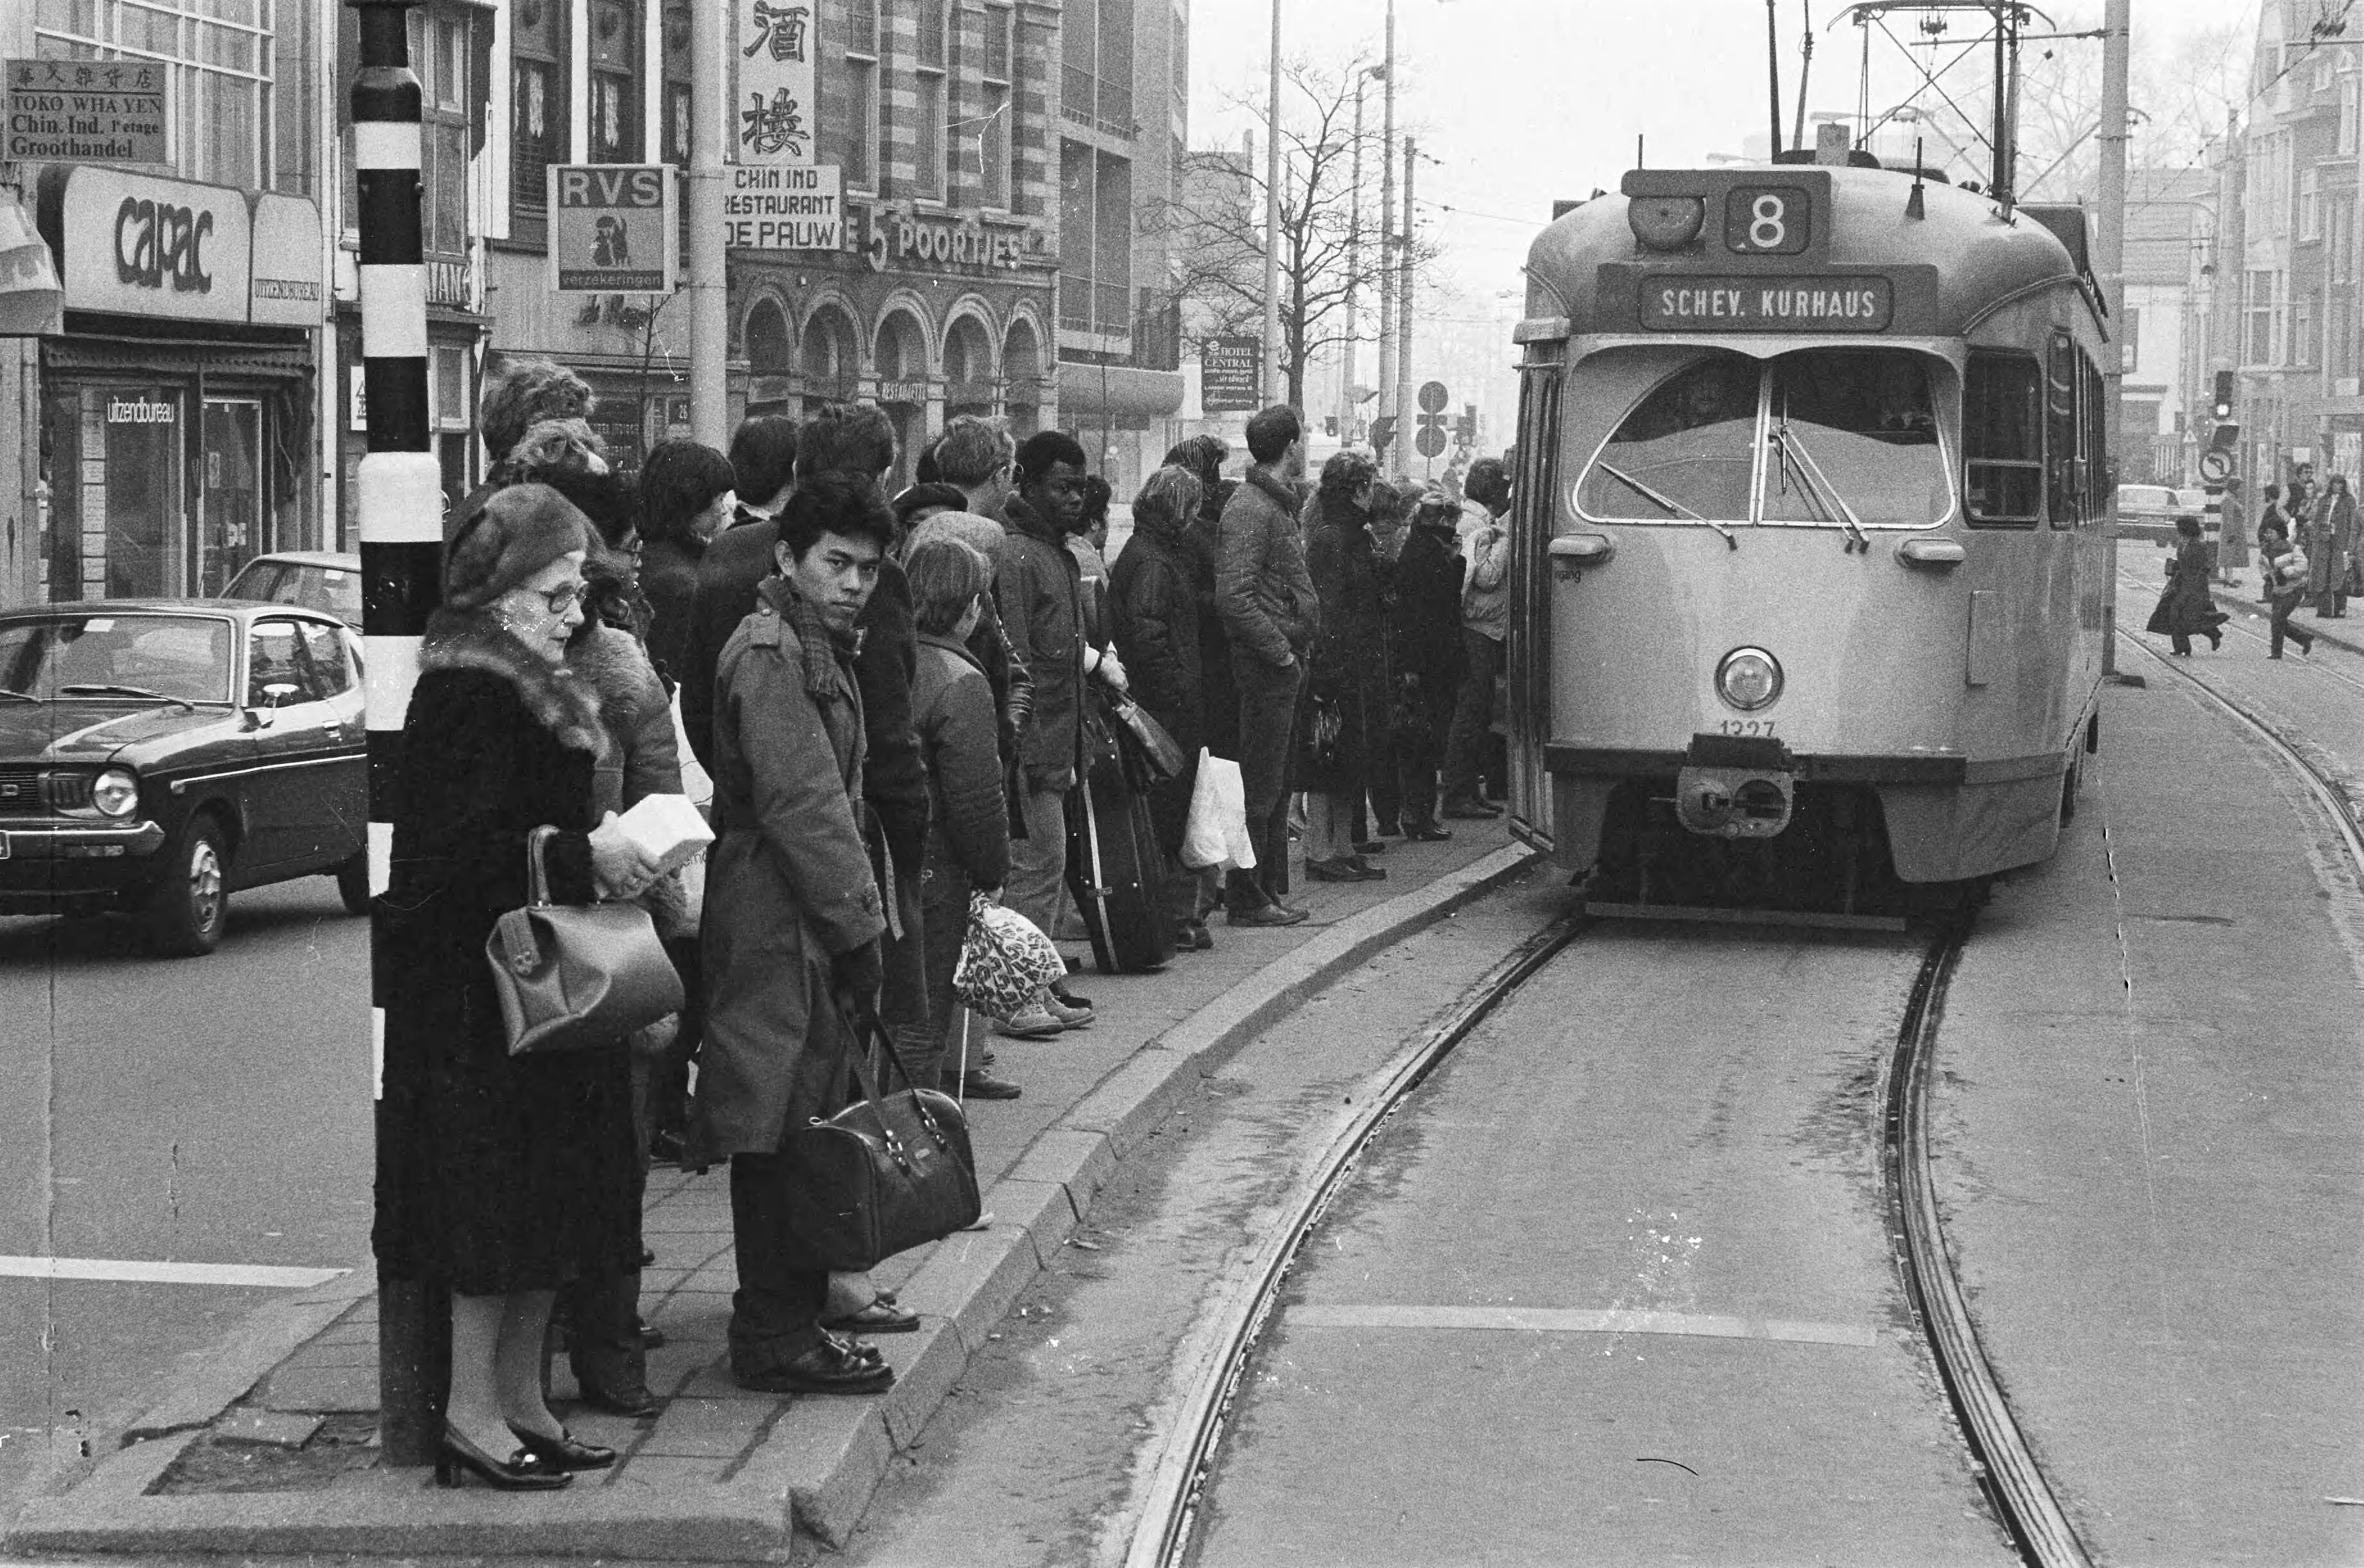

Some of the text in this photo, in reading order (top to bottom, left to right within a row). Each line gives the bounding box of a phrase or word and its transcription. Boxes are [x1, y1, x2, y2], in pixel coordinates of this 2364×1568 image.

[11, 96, 161, 113] TOKO WHA YEN
[11, 115, 63, 133] Chin.
[67, 116, 105, 134] Ind.
[123, 122, 160, 135] etage
[10, 136, 132, 157] Groothandel
[563, 171, 659, 205] RVS
[735, 170, 817, 188] CHIN IND
[1750, 194, 1785, 248] 8
[760, 222, 835, 246] PAUW
[869, 205, 887, 272] 5
[900, 223, 1021, 268] POORTJES
[115, 196, 214, 295] capac
[255, 279, 320, 301] UITZENDBUREAU
[563, 274, 661, 288] verzekeringen
[1662, 290, 1875, 317] SCHEV. KURHAUS
[1204, 358, 1253, 367] CENTRAL
[1221, 347, 1253, 356] HOTEL
[107, 395, 174, 423] uitzendbureau
